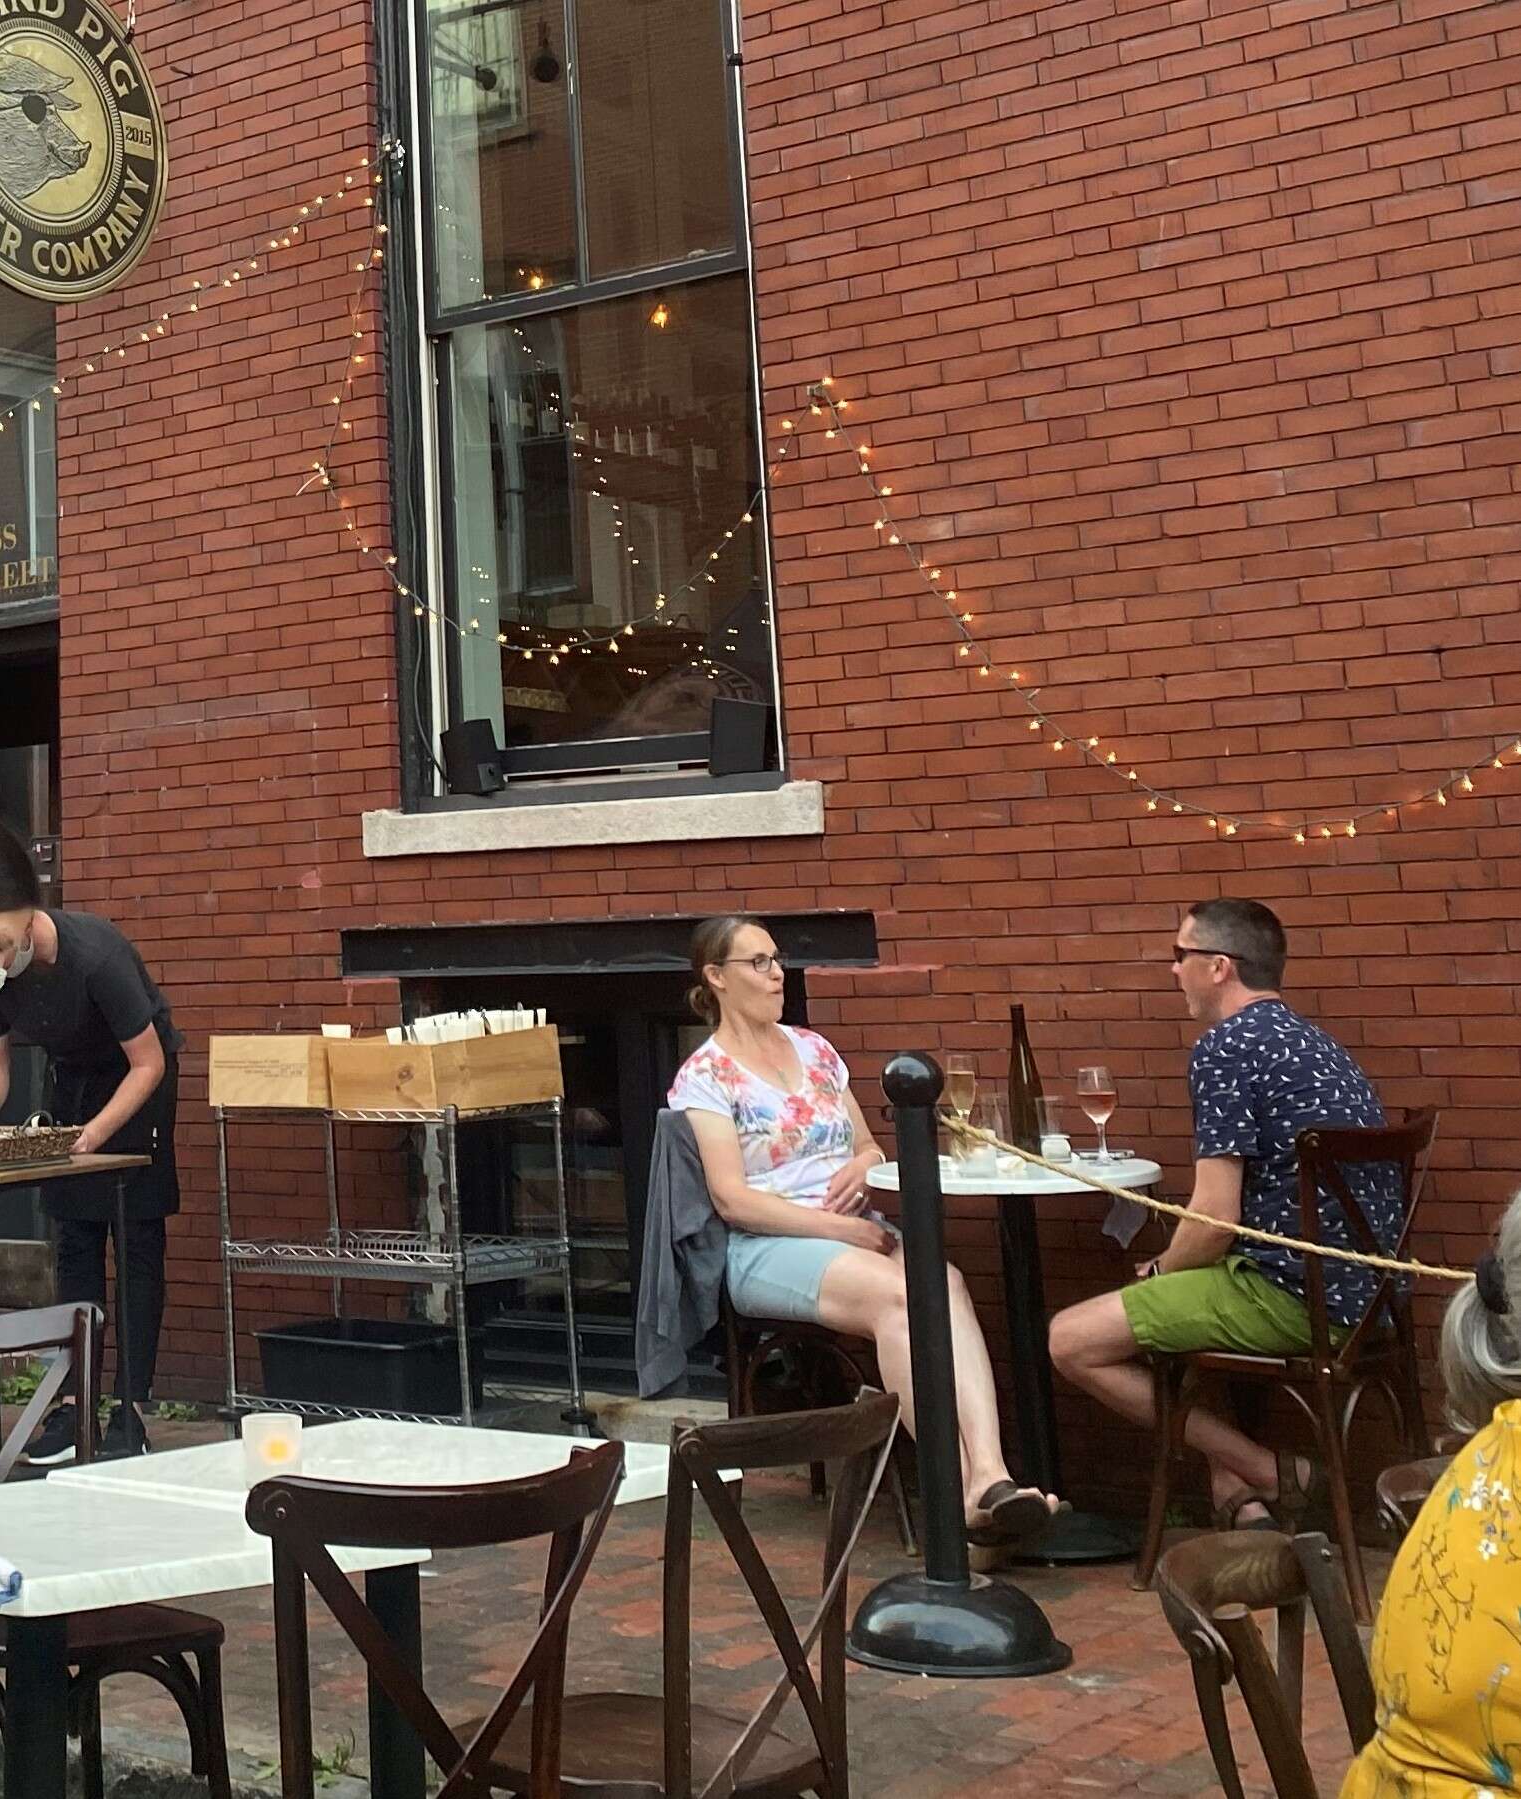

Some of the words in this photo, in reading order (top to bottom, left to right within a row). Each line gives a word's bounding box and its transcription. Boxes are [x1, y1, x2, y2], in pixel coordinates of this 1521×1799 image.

[75, 7, 139, 98] PIG
[125, 125, 152, 148] 2015
[32, 164, 149, 276] COMPANY
